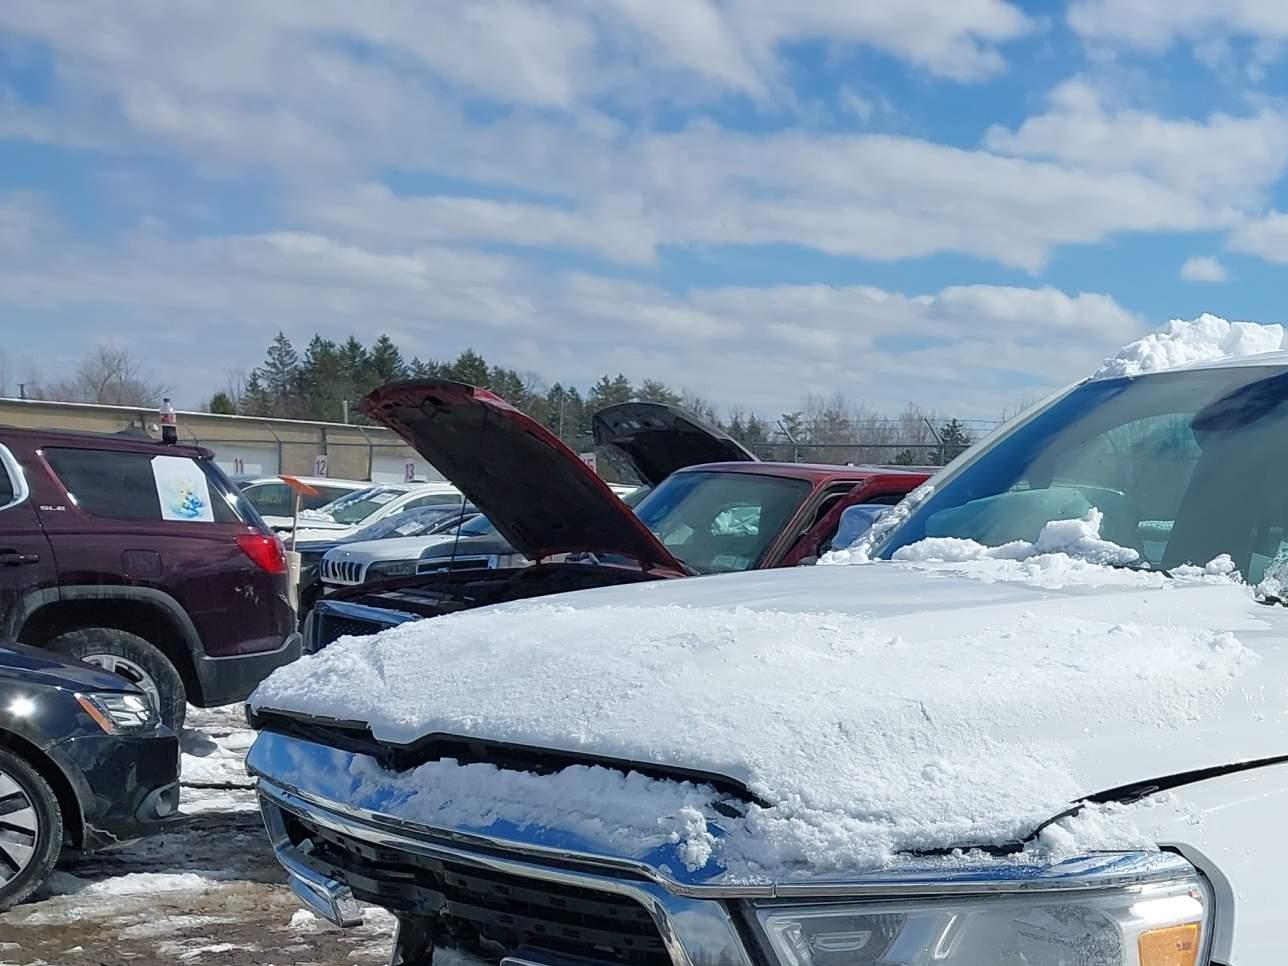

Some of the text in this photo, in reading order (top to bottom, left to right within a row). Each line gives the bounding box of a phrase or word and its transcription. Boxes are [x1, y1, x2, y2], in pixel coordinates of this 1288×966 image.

[233, 456, 244, 474] 11
[315, 459, 326, 476] 12
[405, 462, 415, 480] 13
